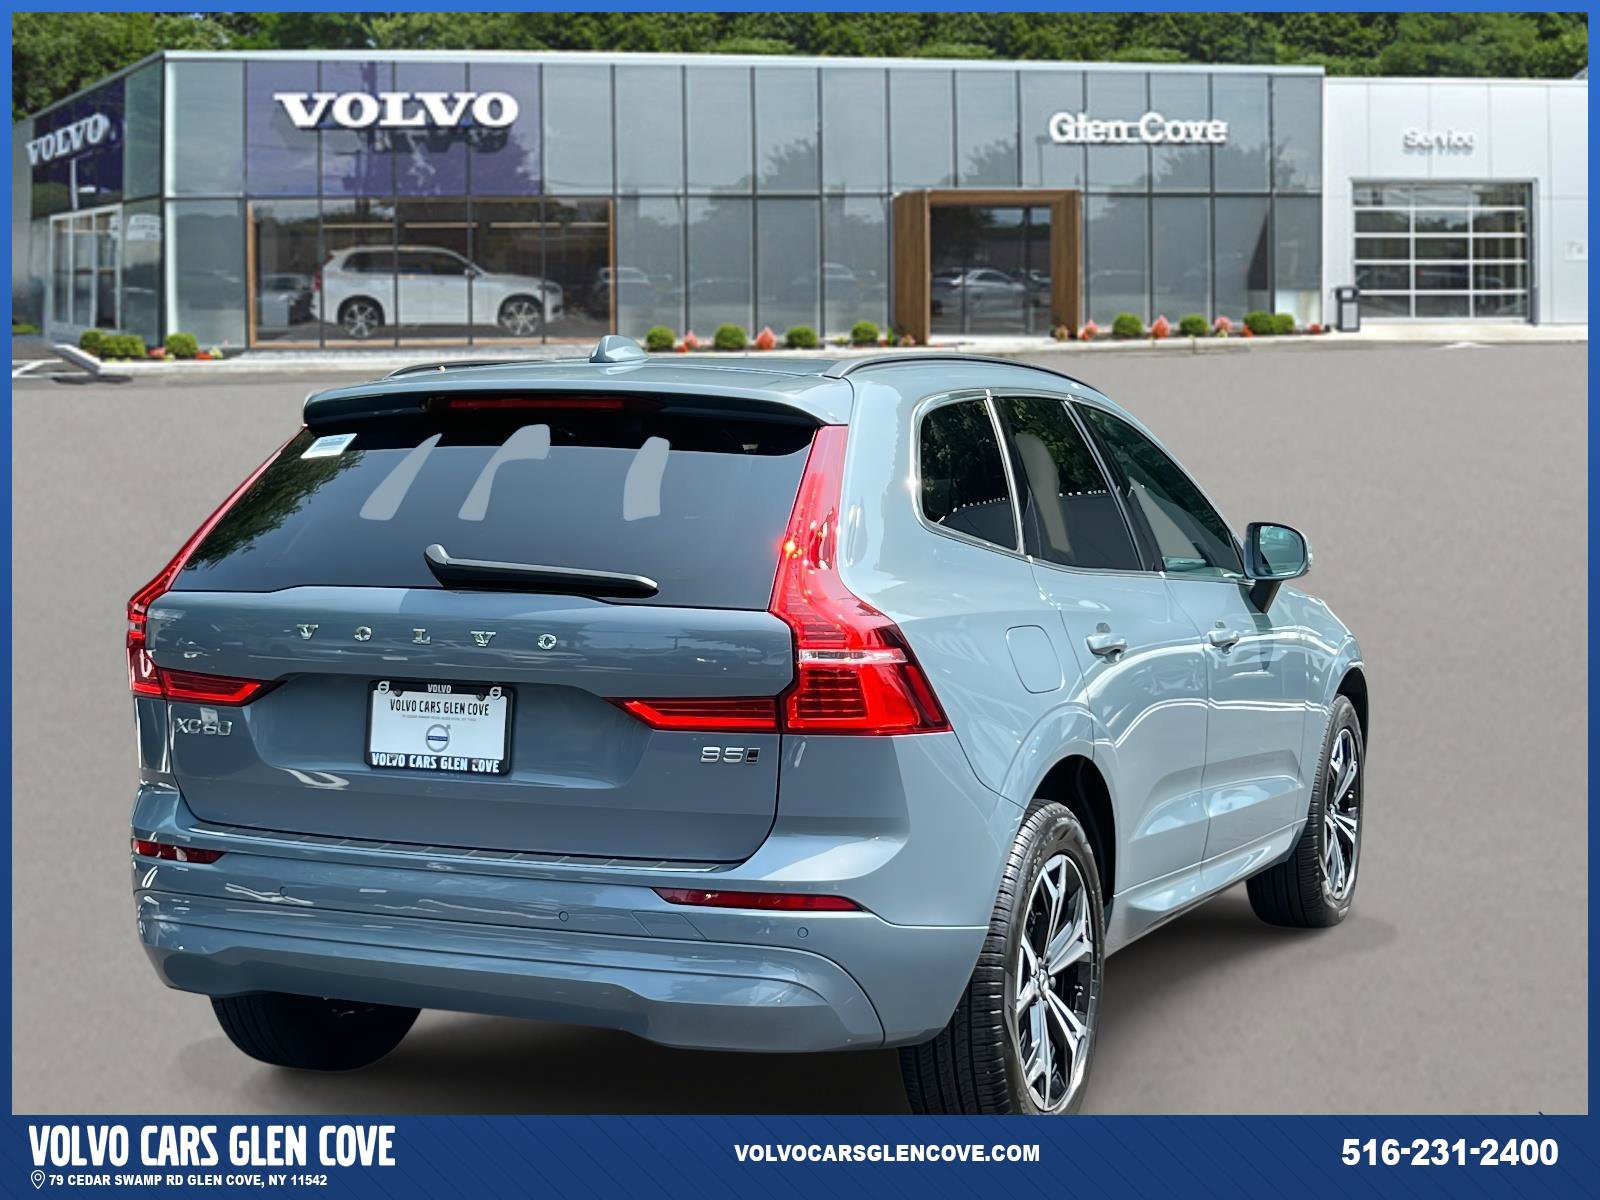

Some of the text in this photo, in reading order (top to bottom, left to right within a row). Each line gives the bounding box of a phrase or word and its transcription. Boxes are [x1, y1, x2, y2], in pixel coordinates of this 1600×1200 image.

[273, 91, 519, 129] VOLVO
[27, 112, 110, 165] VOLVO
[1049, 111, 1228, 144] Glen Cove
[1403, 127, 1475, 154] Service
[297, 622, 558, 651] VOLVO
[427, 683, 452, 694] VOLVO
[390, 698, 490, 716] VOLVO CARS GLEN COVE
[371, 752, 500, 773] VOLVO CARS GLEN COVE
